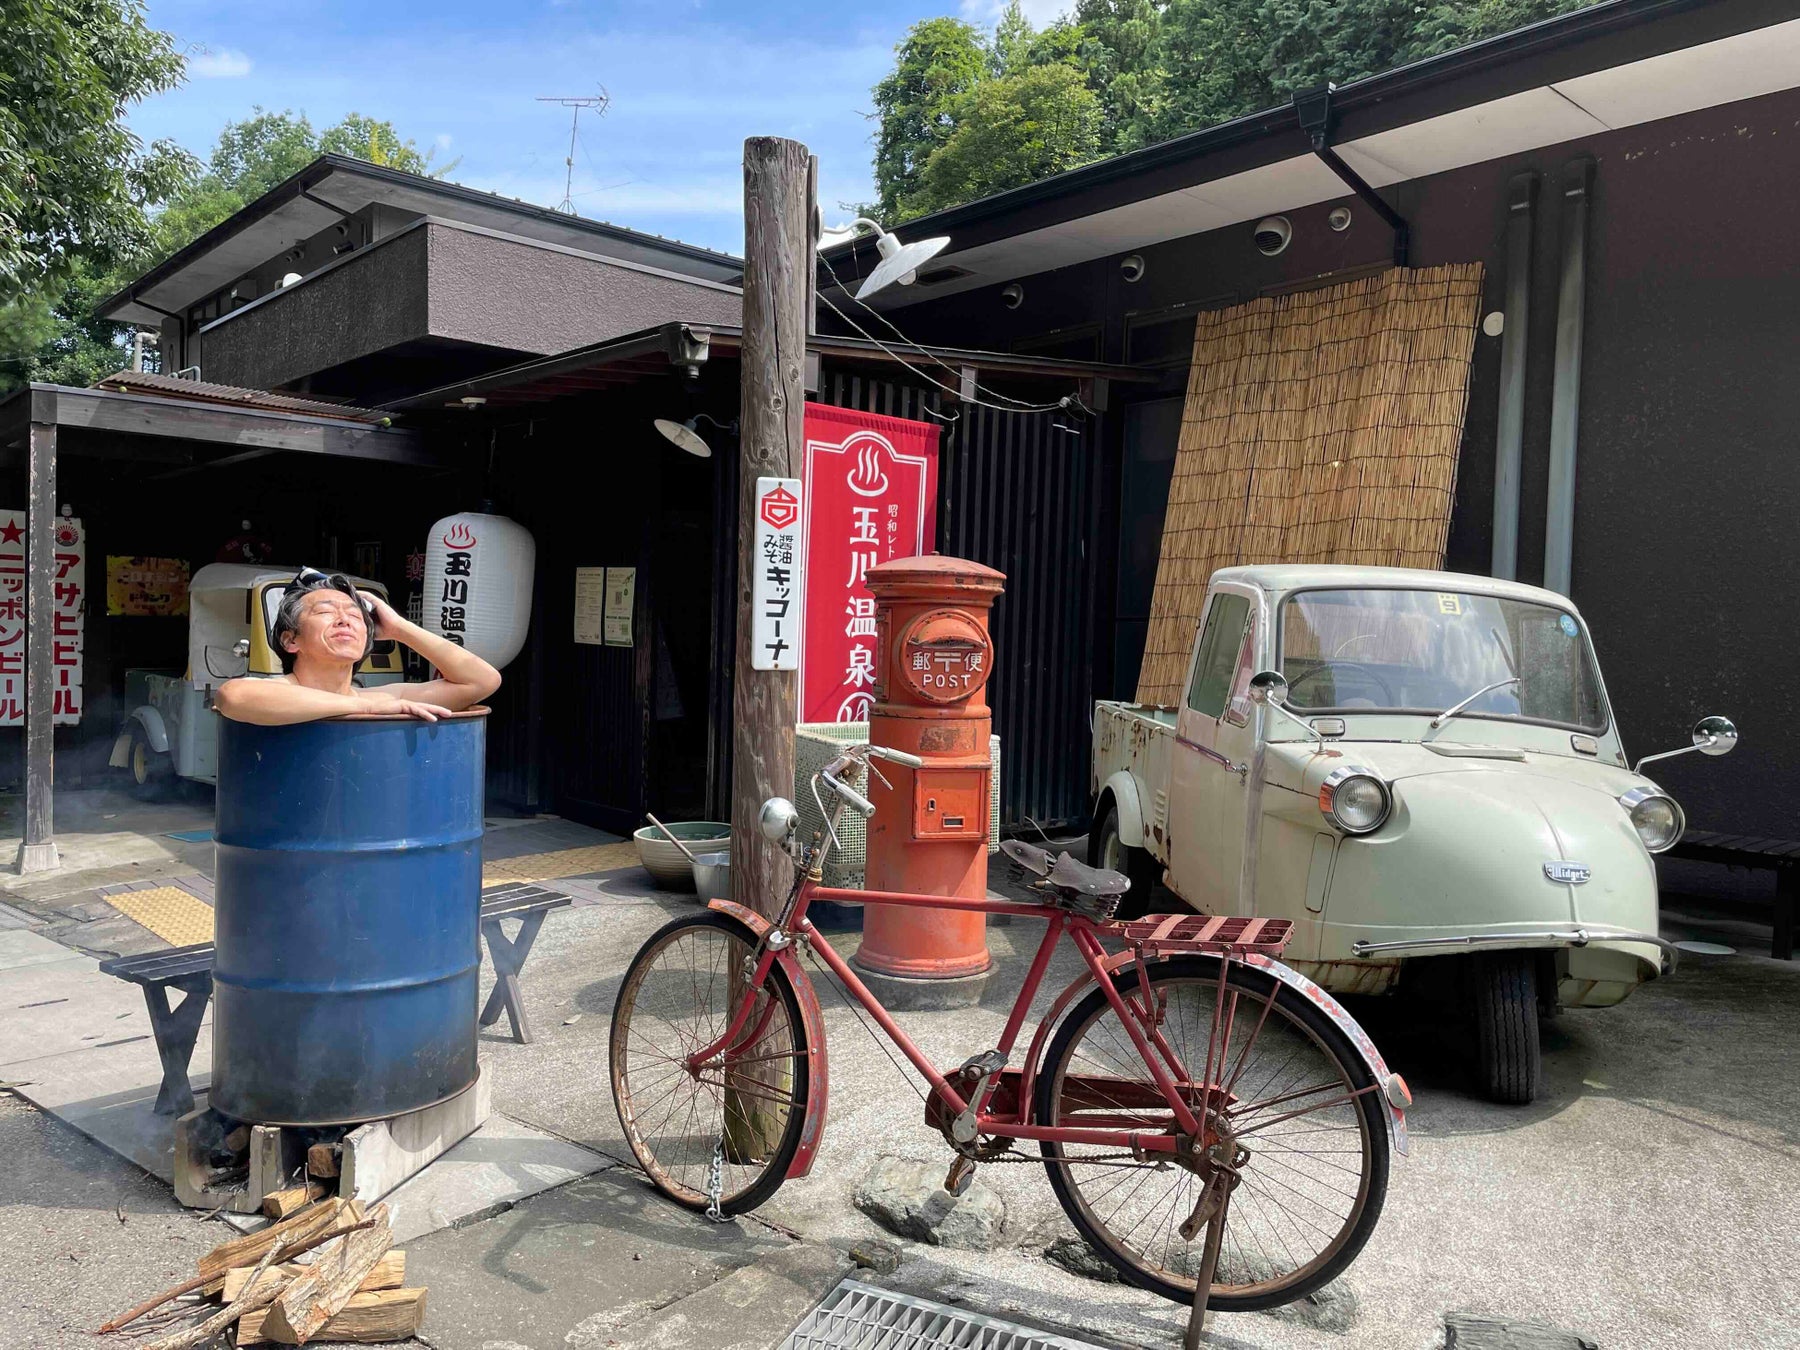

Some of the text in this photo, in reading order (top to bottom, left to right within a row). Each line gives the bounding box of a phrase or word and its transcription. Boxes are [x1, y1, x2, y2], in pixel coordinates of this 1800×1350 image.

[763, 534, 779, 564] みそ
[765, 566, 791, 660] キッコーナ
[923, 674, 971, 688] POST
[1552, 865, 1588, 881] Midget
